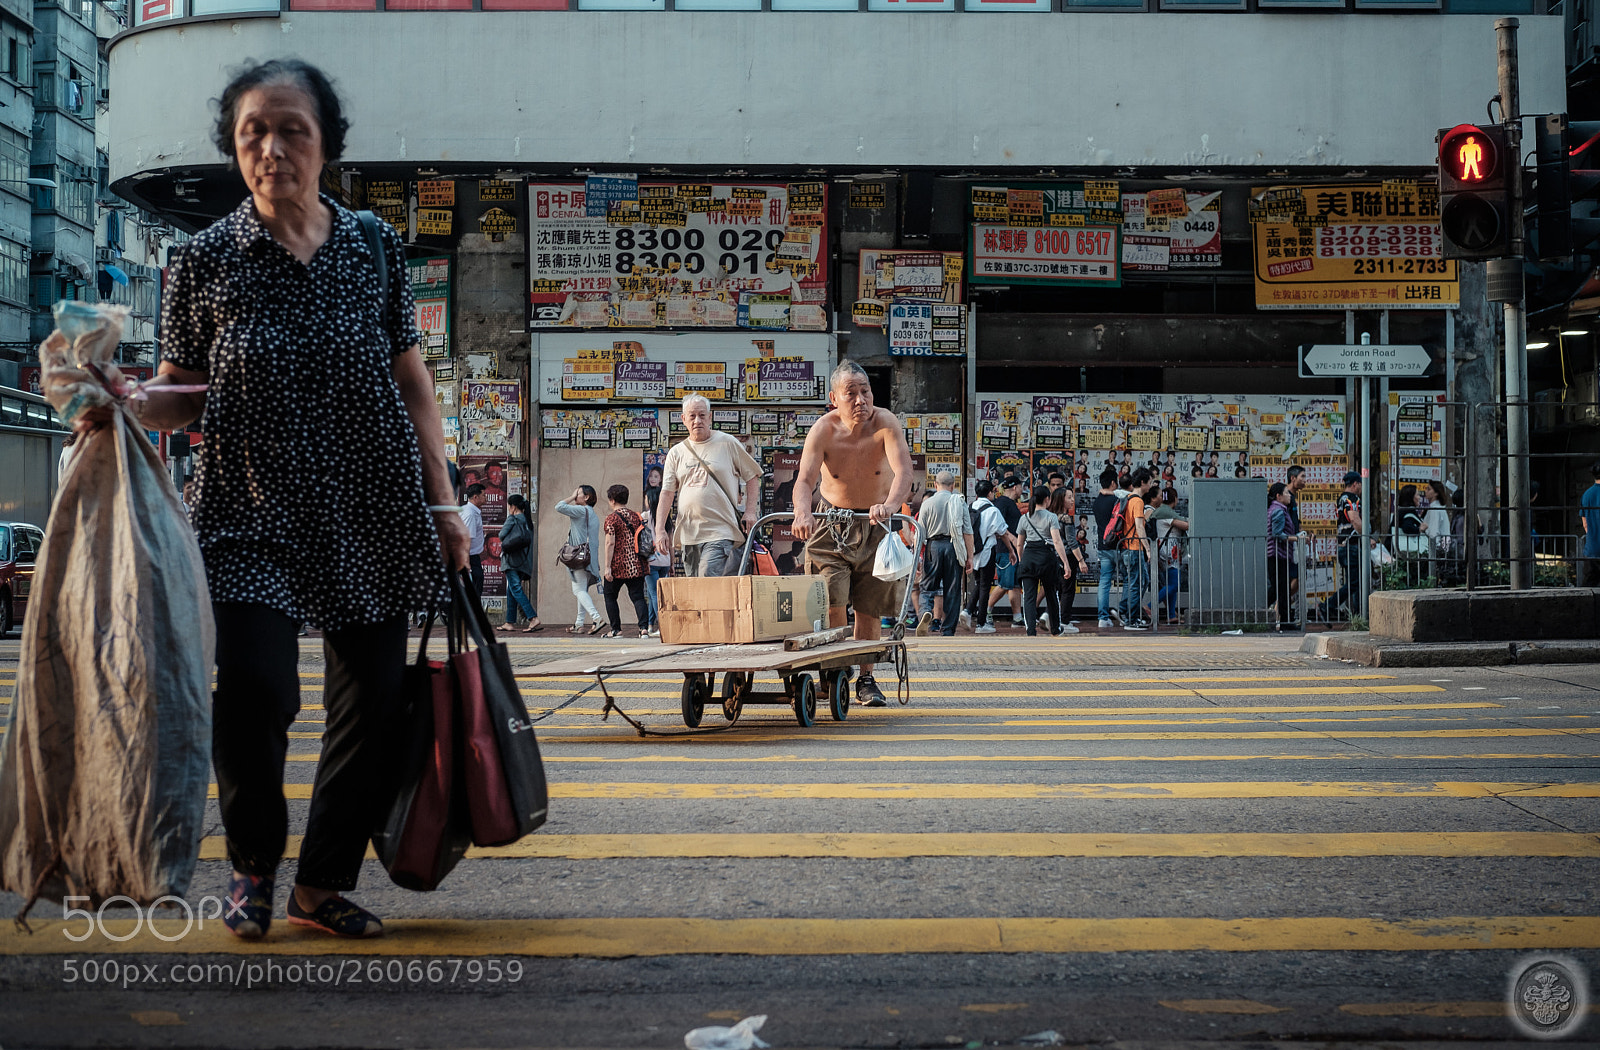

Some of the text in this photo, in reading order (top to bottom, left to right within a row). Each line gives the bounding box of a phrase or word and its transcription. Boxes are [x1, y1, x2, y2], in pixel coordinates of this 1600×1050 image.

[1184, 221, 1215, 232] 0448
[536, 229, 611, 245] 沈應龍先生
[614, 228, 705, 250] 8300
[1034, 229, 1070, 254] 8100
[1076, 230, 1111, 256] 6517
[1319, 236, 1441, 246] 8208-028
[1319, 246, 1441, 257] 8105-568
[615, 252, 705, 275] 8300
[1269, 259, 1313, 276] 特約代理
[1354, 259, 1447, 275] 2311-2733
[1404, 285, 1441, 300] 出租
[421, 305, 442, 330] 6517
[893, 331, 912, 339] 6039
[1340, 349, 1396, 357] Jordan Road
[618, 362, 658, 380] PrimeShop
[761, 362, 802, 378] PrimeShop
[1349, 361, 1387, 372] 佐敦道
[618, 382, 664, 391] 2111 3555
[762, 382, 808, 391] 2111 3555
[1334, 427, 1343, 440] 46
